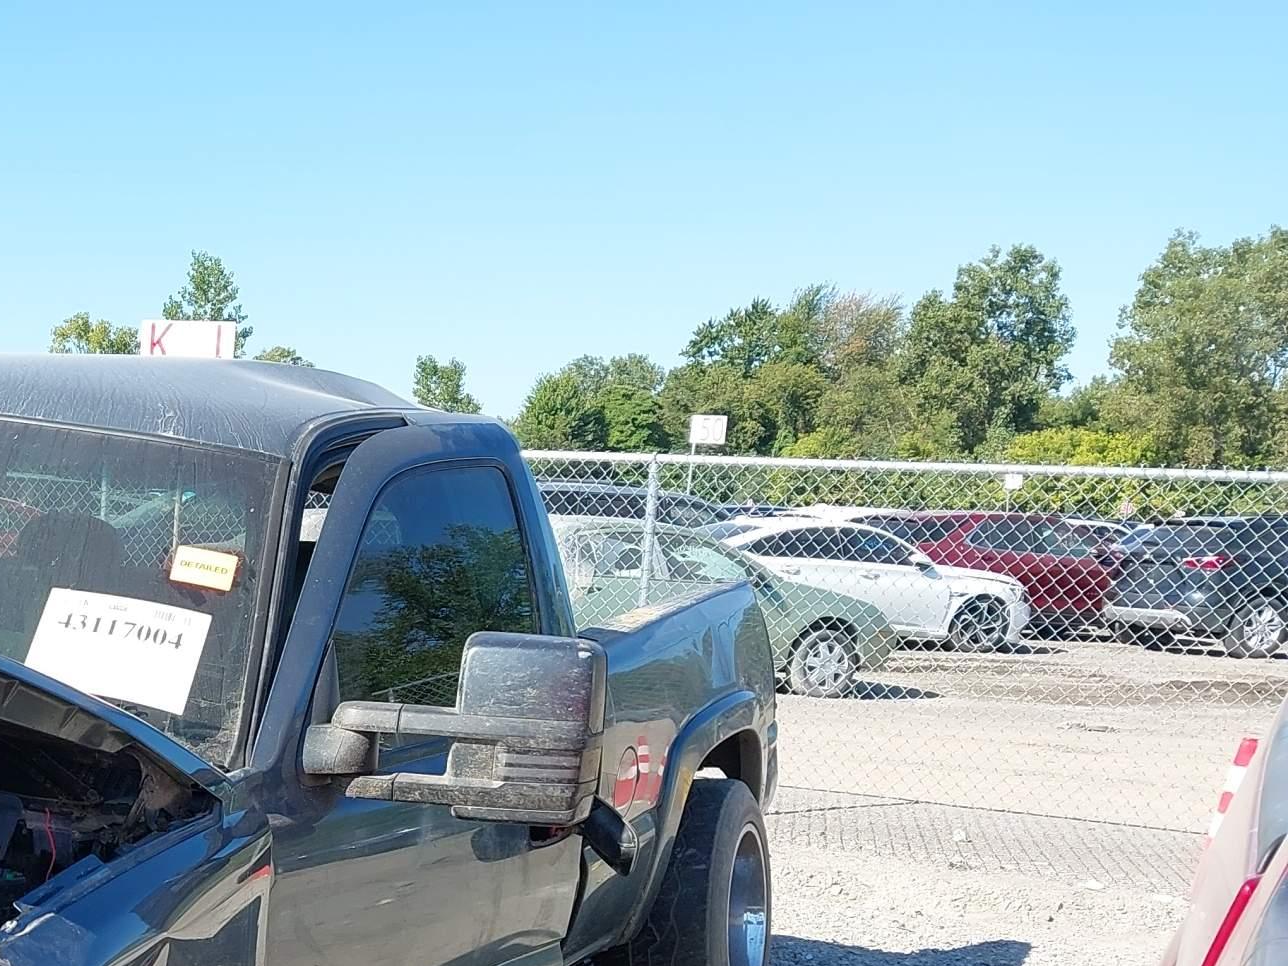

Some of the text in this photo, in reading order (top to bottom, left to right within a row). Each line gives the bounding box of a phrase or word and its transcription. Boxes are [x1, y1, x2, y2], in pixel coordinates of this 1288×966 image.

[149, 322, 173, 356] K
[179, 559, 229, 575] DETAILED
[57, 612, 184, 650] 43117004
